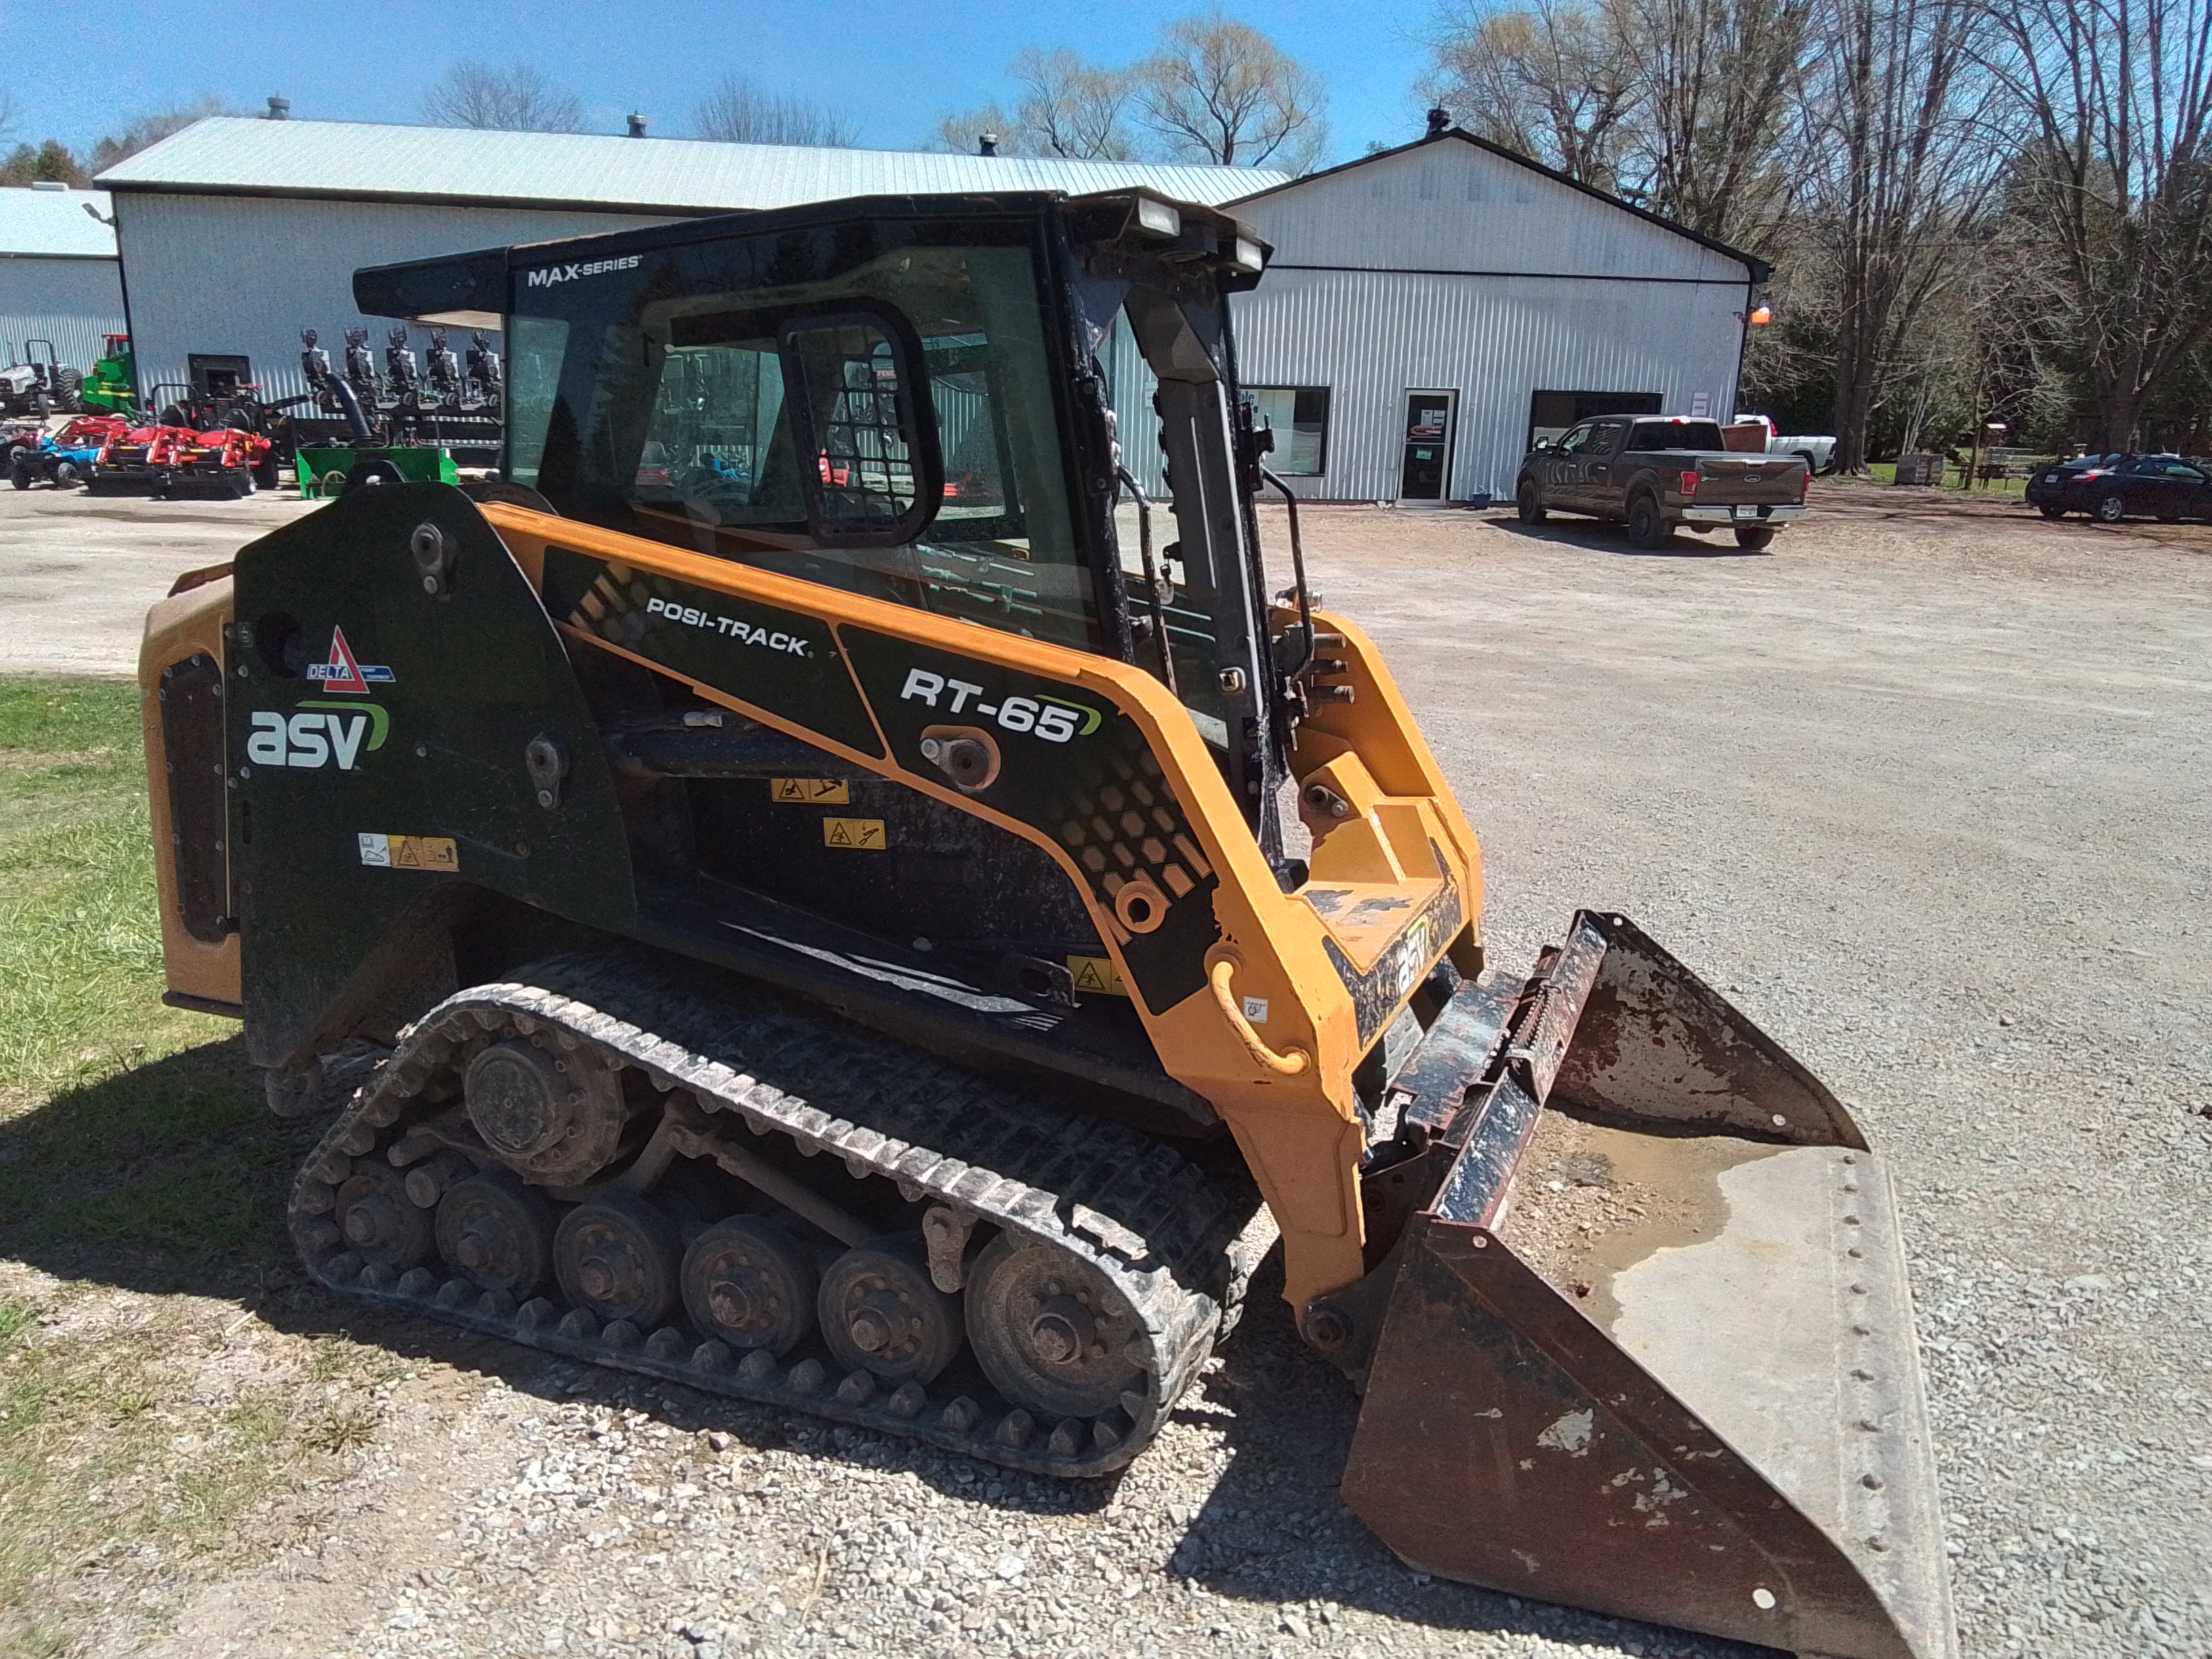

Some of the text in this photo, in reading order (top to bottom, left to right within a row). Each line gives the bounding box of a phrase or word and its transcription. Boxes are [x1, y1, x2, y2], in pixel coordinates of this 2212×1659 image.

[528, 255, 639, 287] MAX-SERIES
[646, 597, 810, 656] POSI-TRACK
[309, 666, 350, 678] DELTA
[900, 668, 1080, 743] RT-65
[247, 711, 367, 770] asv
